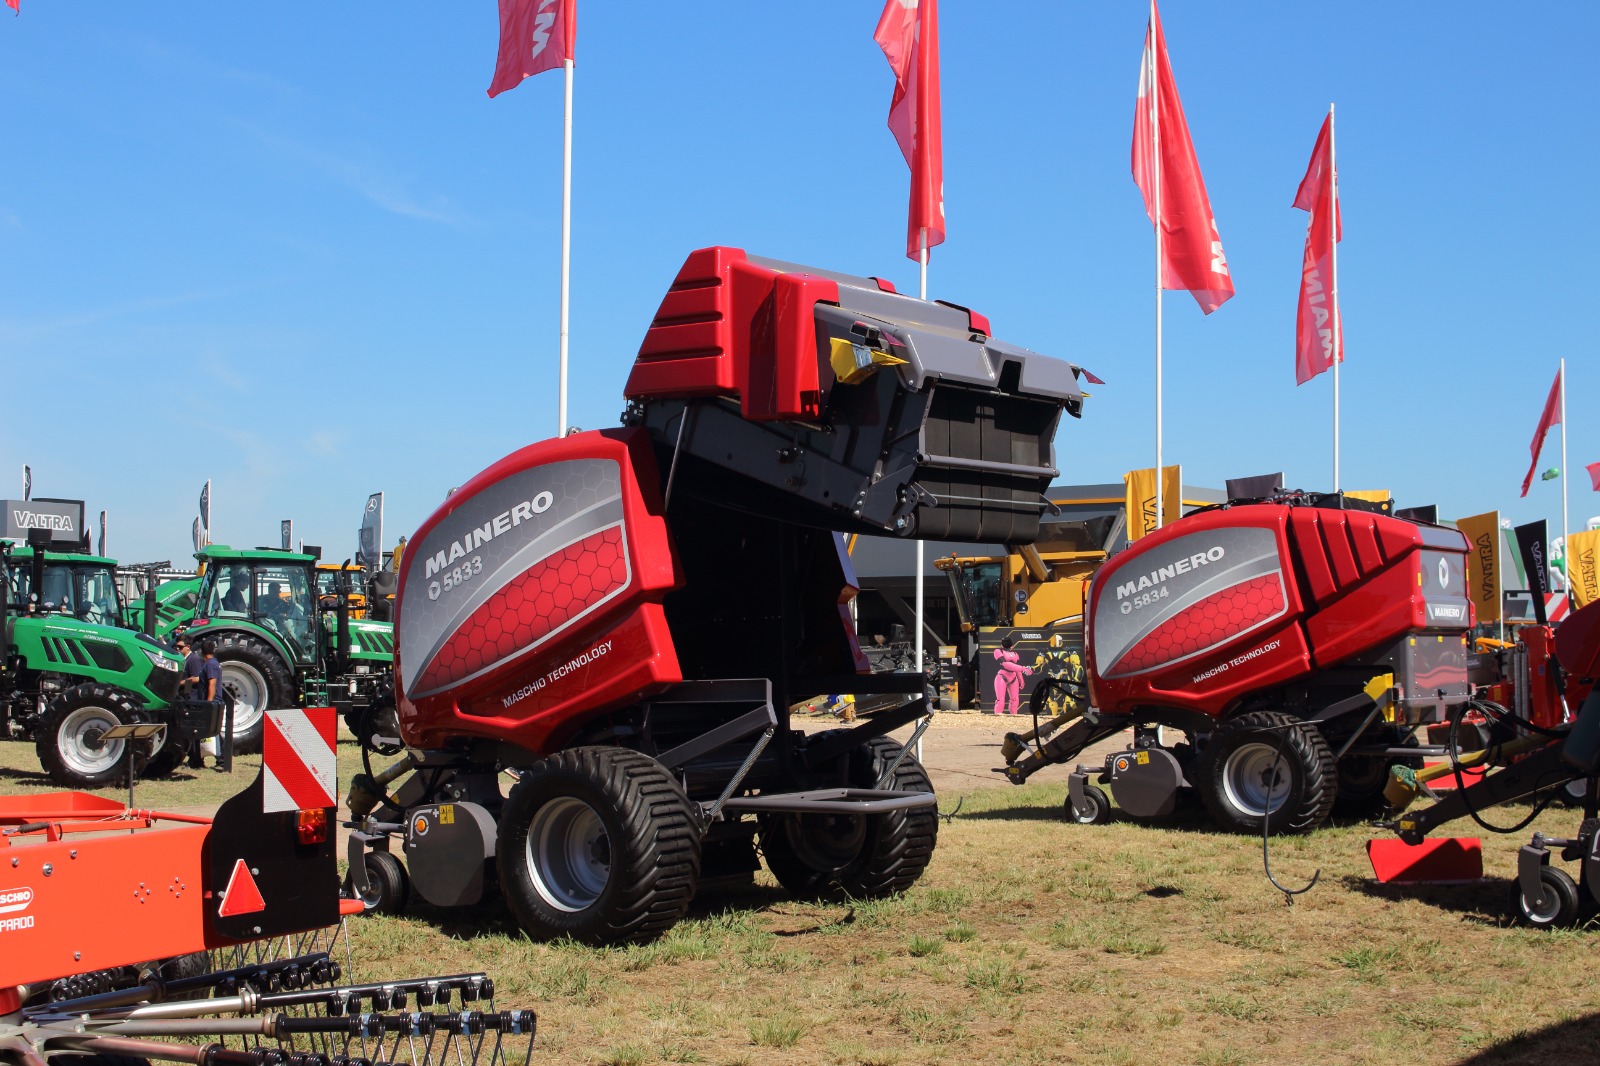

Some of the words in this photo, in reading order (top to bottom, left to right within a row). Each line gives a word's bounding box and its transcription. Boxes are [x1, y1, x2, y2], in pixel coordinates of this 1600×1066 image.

[13, 510, 74, 531] VALTRA
[425, 490, 554, 580] MAINERO
[442, 555, 483, 592] 5833
[1116, 546, 1225, 600] MAINERO
[1476, 532, 1496, 602] VALTRA
[1578, 548, 1600, 602] VALTR
[1134, 585, 1170, 610] 5834
[1434, 607, 1460, 618] MAINERO
[503, 676, 547, 708] MASCHIO
[546, 640, 614, 683] TECHNOLOGY
[1192, 663, 1229, 684] MASCHIO
[1228, 640, 1281, 668] TECHNOLOGY
